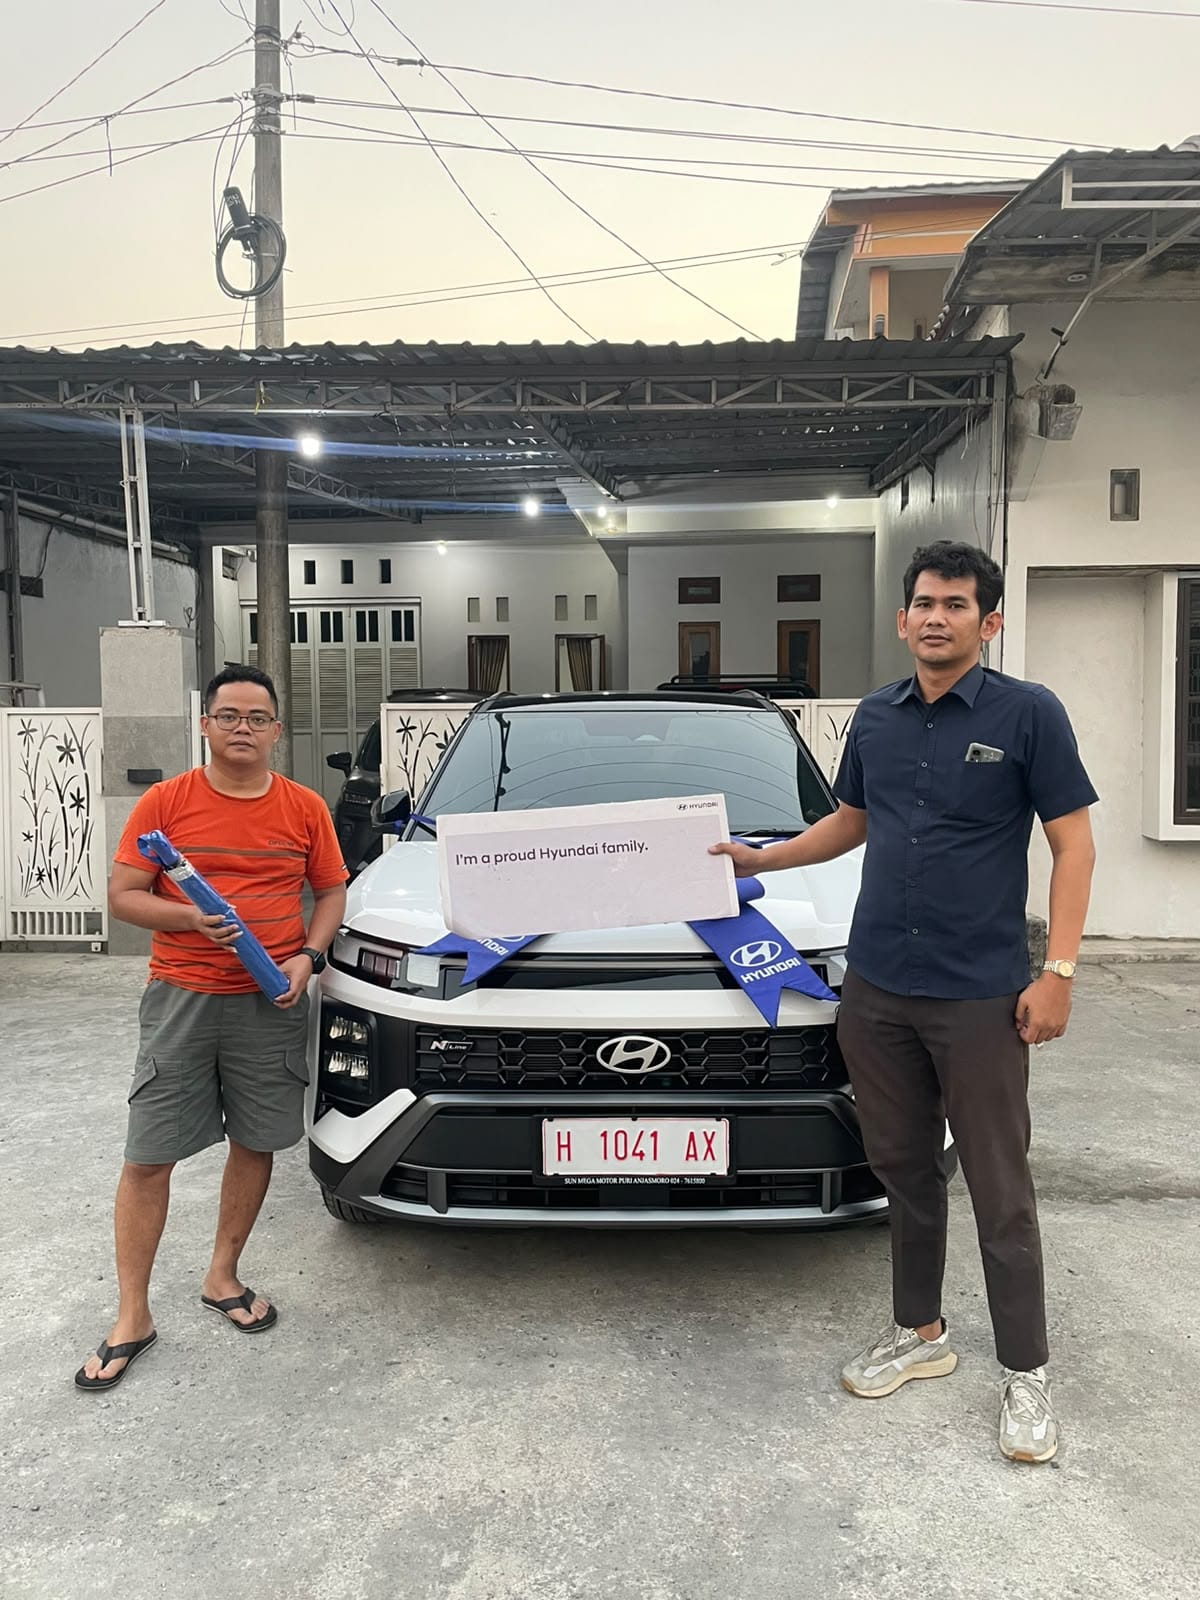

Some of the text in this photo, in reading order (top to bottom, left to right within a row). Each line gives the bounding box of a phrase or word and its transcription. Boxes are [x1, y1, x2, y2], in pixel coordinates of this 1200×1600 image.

[689, 801, 719, 809] HYUNDAI
[456, 839, 649, 865] I'm a proud Hyundai family.
[475, 937, 509, 956] NDAI
[740, 957, 802, 984] HYUNDAI
[430, 1040, 449, 1050] N
[556, 1129, 716, 1162] H 1041 AX
